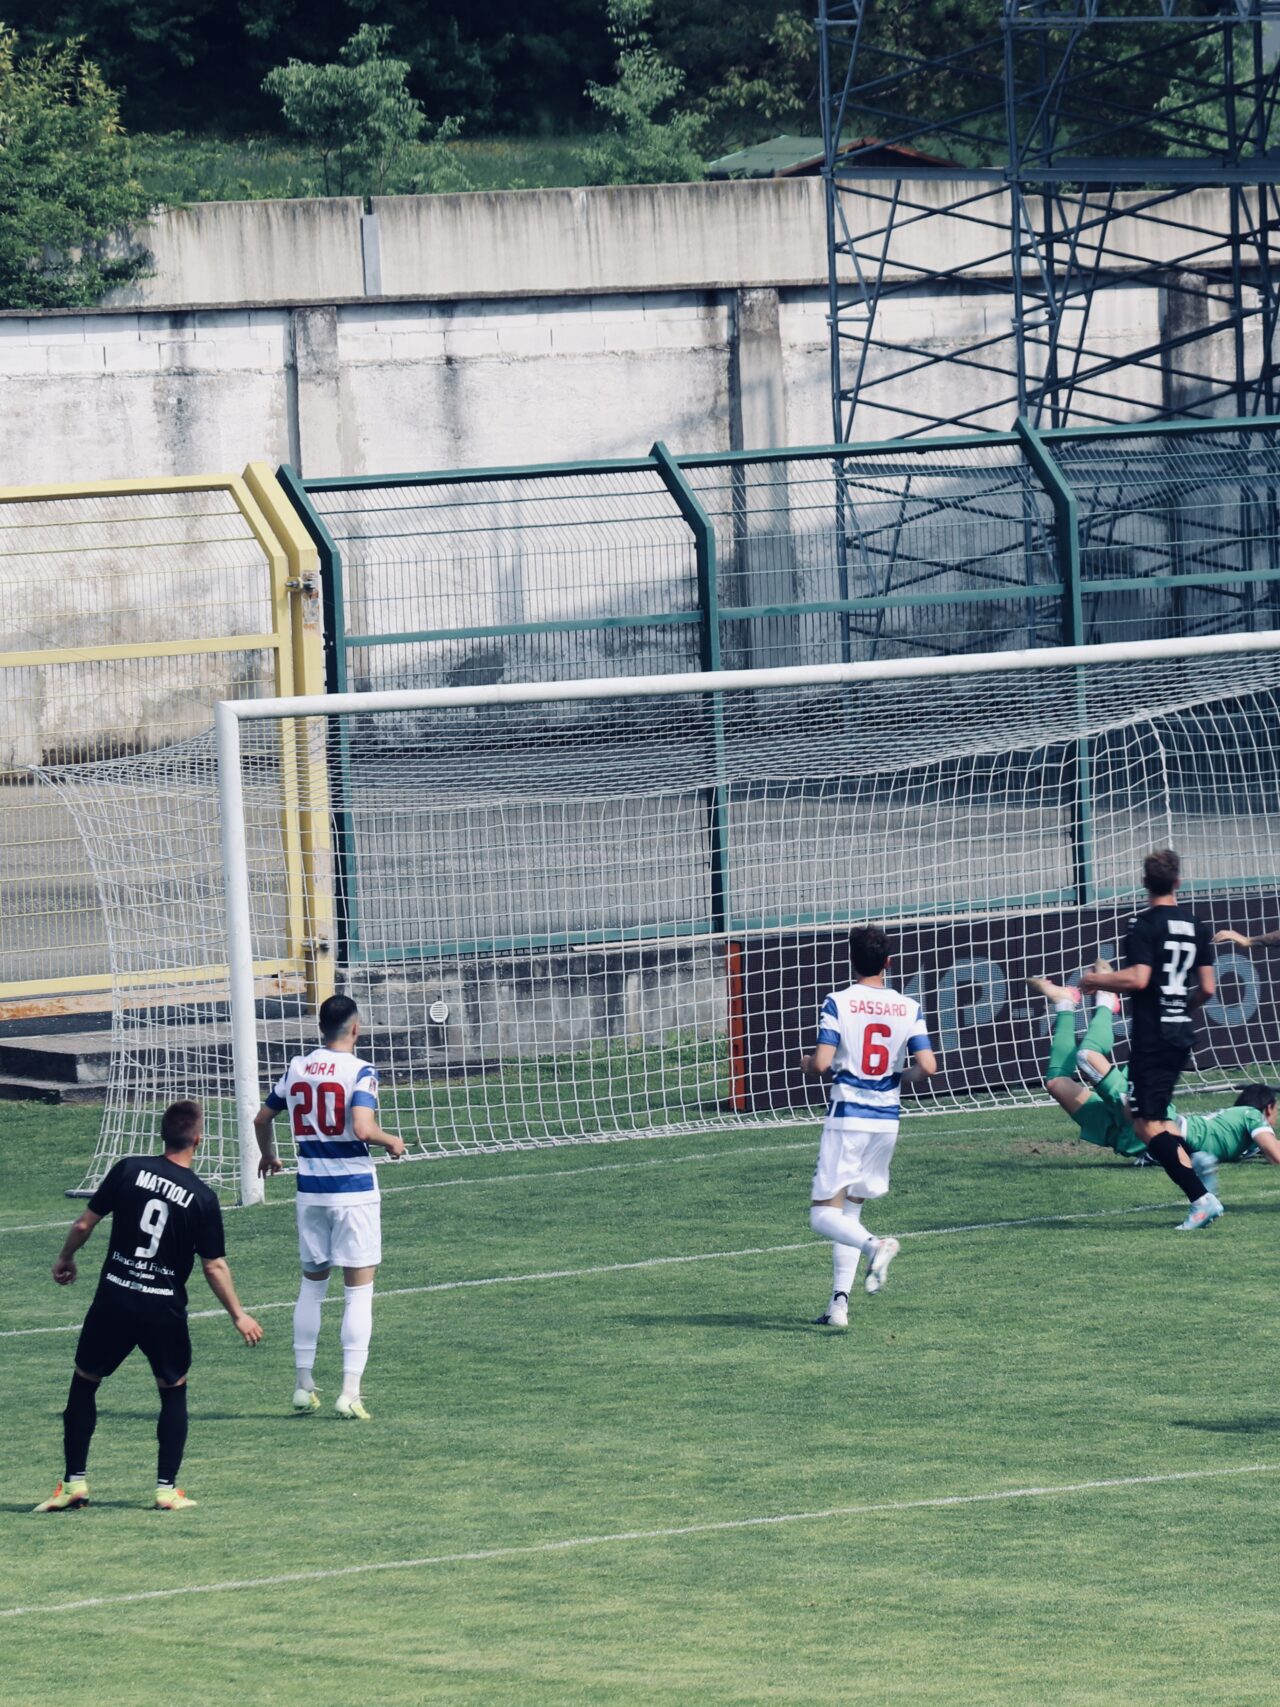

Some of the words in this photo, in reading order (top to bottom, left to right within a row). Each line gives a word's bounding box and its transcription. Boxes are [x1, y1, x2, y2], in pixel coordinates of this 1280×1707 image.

[849, 999, 908, 1017] SASSARO
[304, 1061, 336, 1077] MORA
[861, 1022, 892, 1076] 6
[289, 1081, 346, 1136] 20
[135, 1169, 195, 1208] MATTIOLI
[135, 1198, 170, 1259] 9
